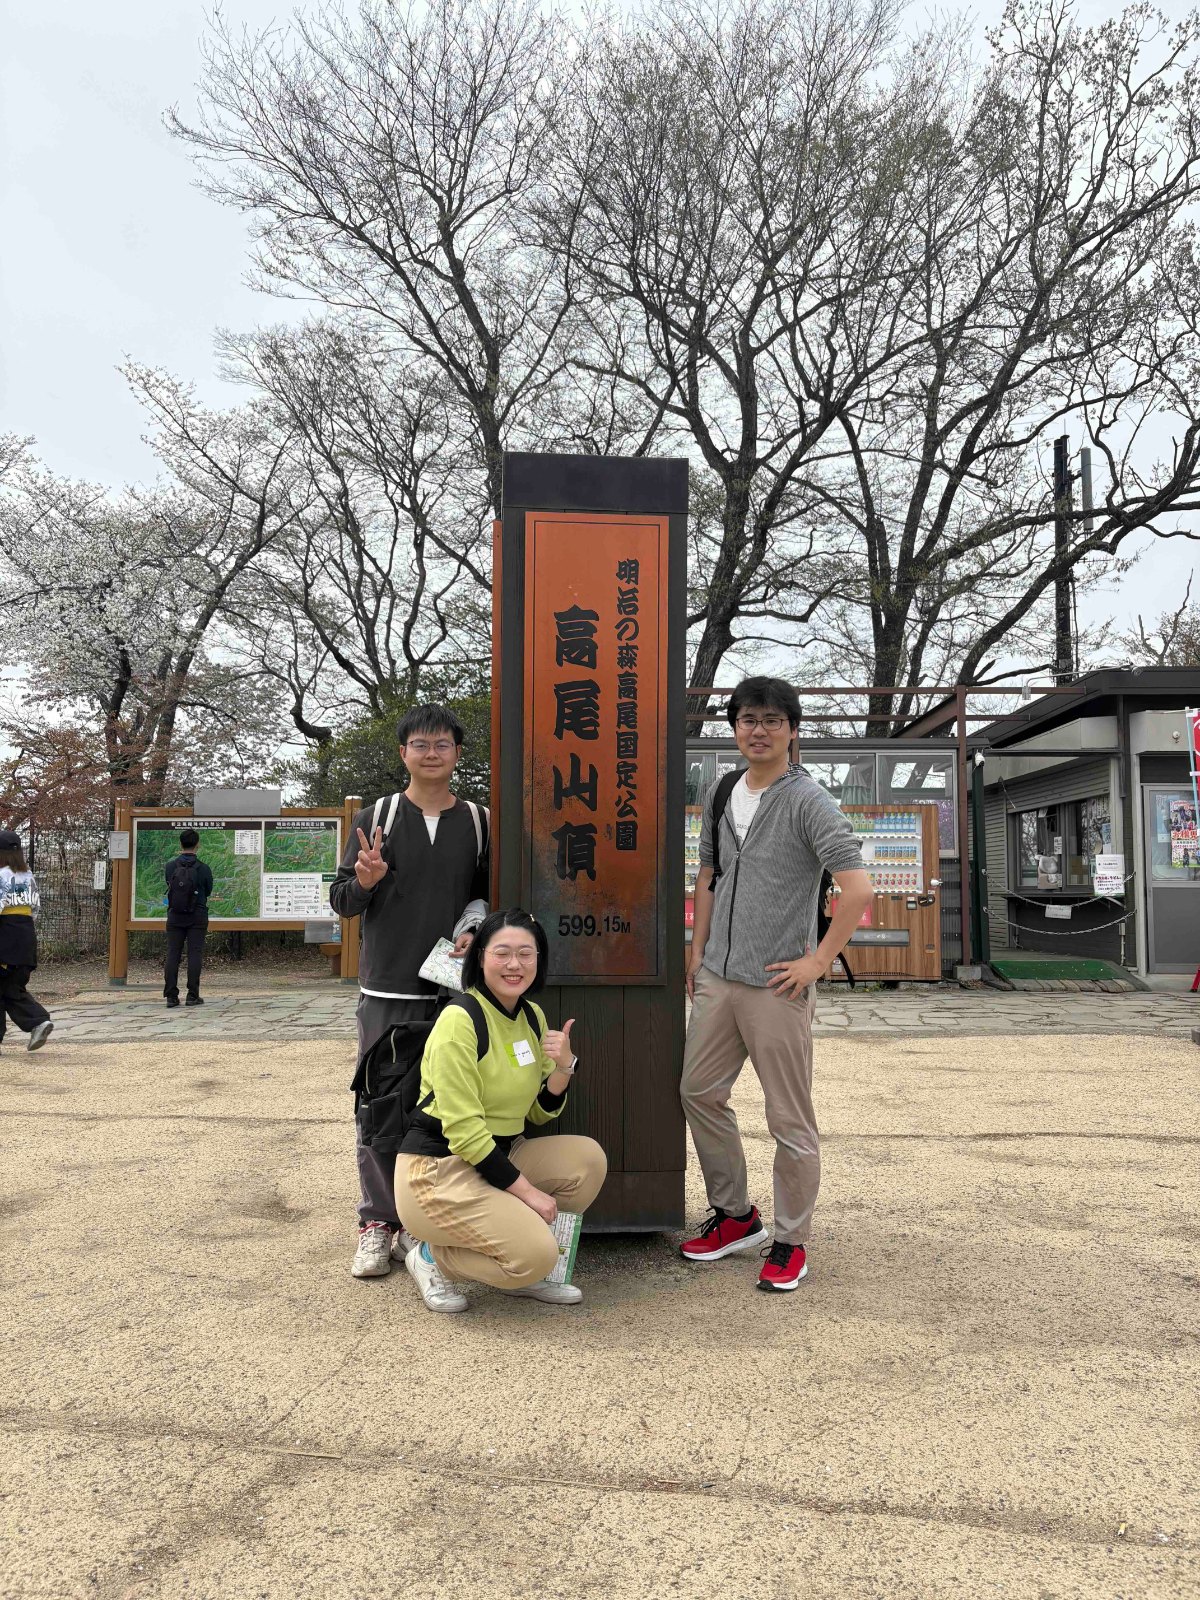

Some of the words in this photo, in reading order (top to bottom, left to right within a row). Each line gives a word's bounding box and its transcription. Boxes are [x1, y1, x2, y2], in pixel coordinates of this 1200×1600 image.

[551, 604, 601, 882] 高尾山頂
[614, 558, 639, 850] 明治の森高尾国定公園
